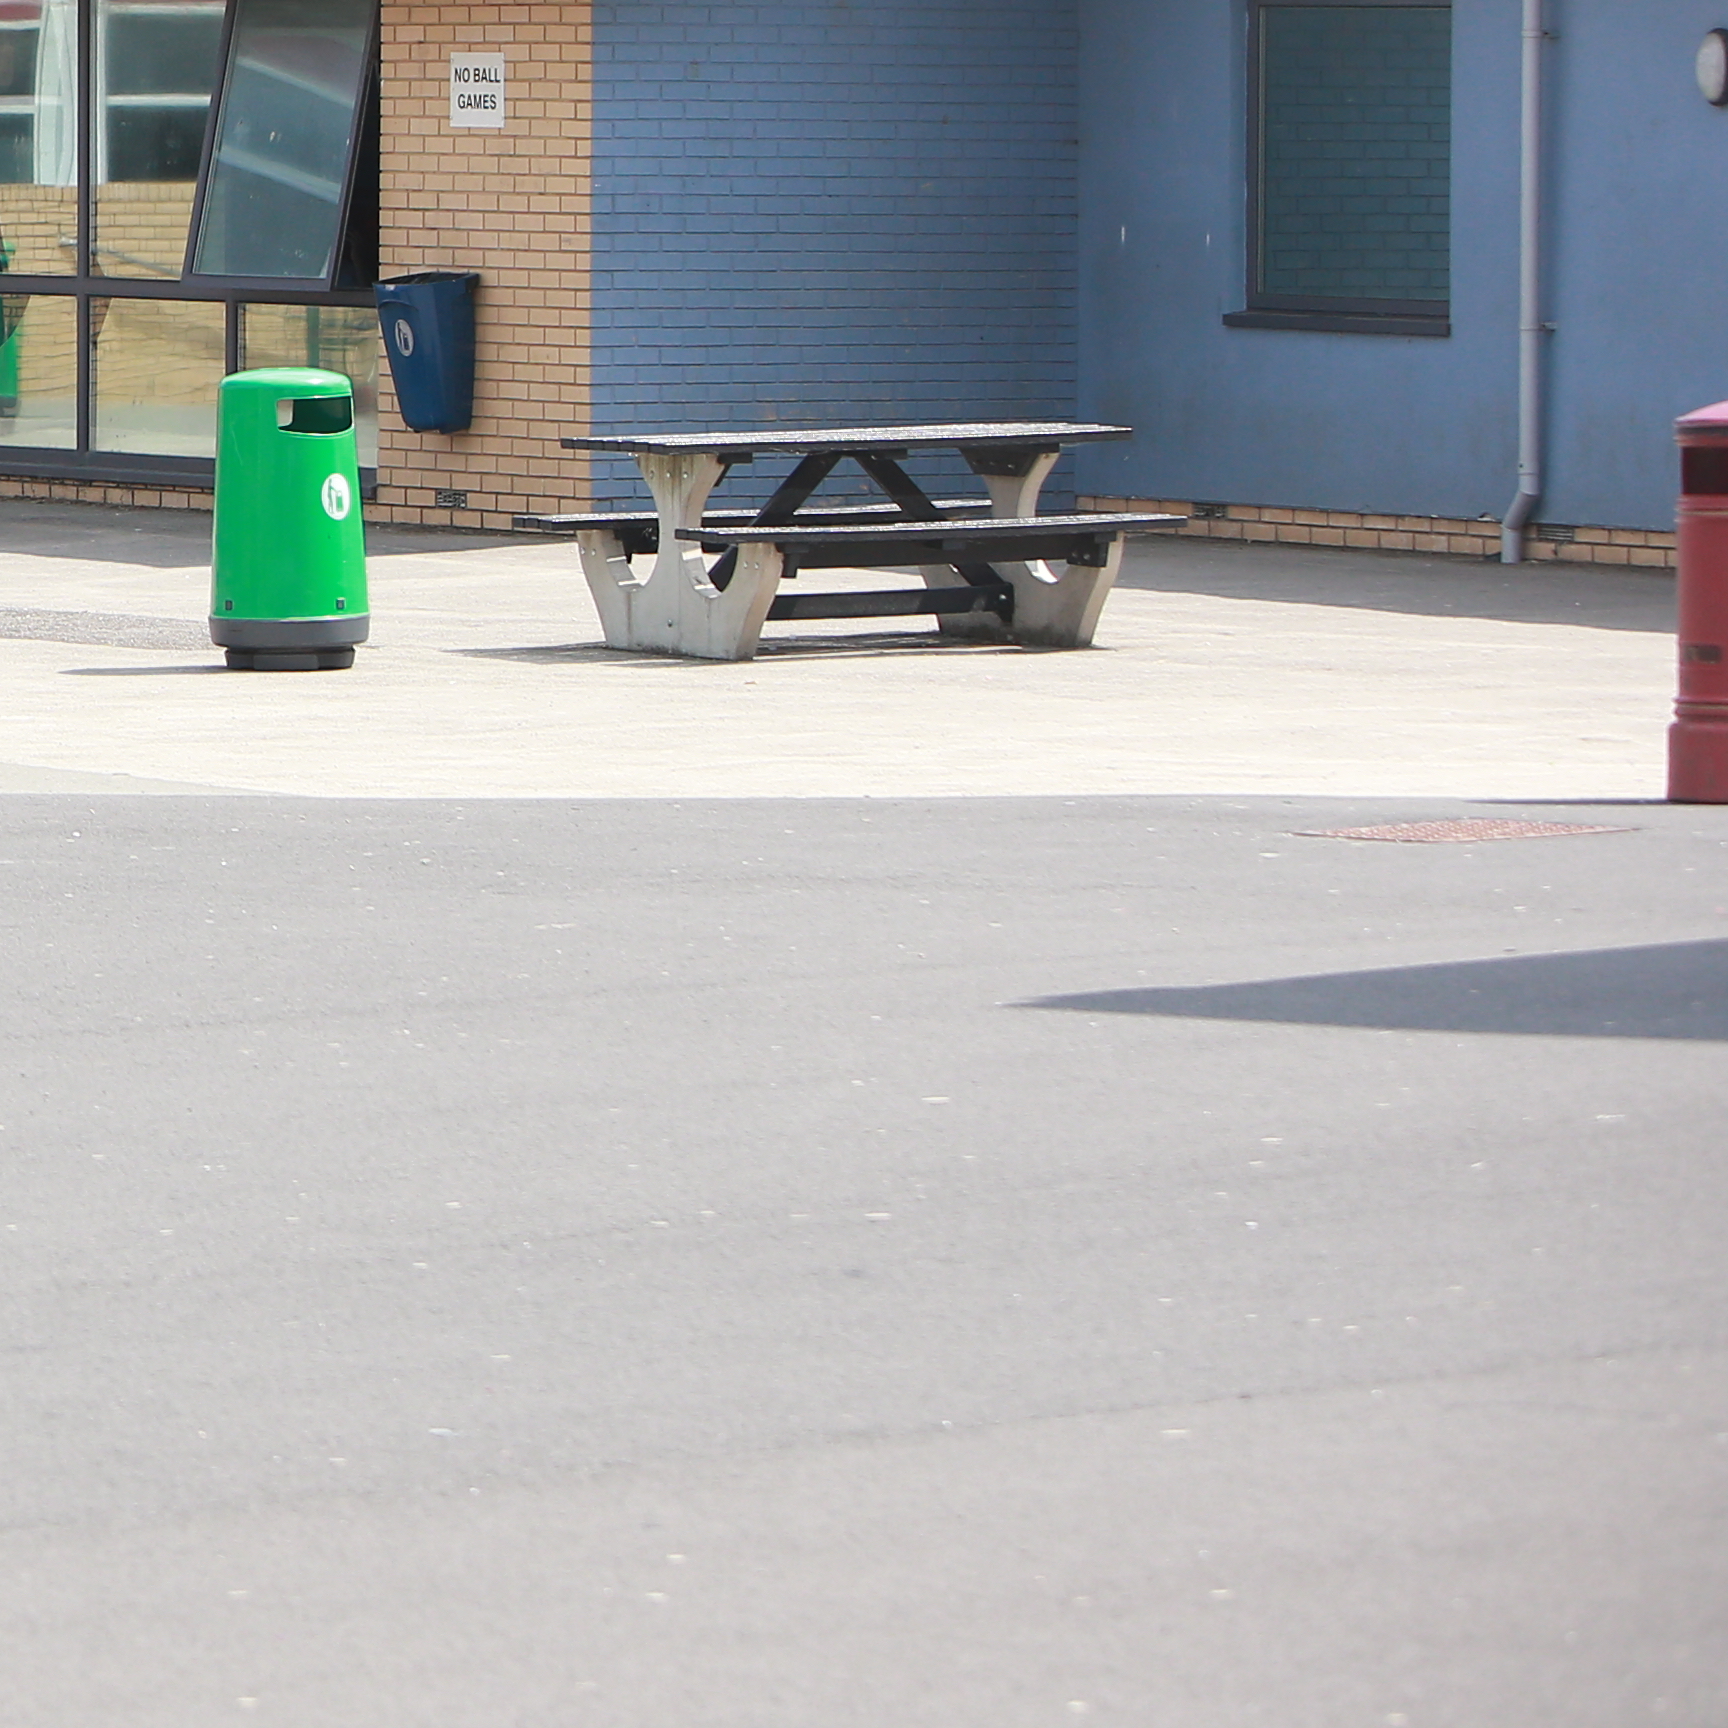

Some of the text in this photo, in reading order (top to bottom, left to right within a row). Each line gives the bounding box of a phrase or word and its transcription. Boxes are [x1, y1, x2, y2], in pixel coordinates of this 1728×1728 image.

[454, 68, 501, 83] NO BALL
[457, 94, 497, 110] GAMES
